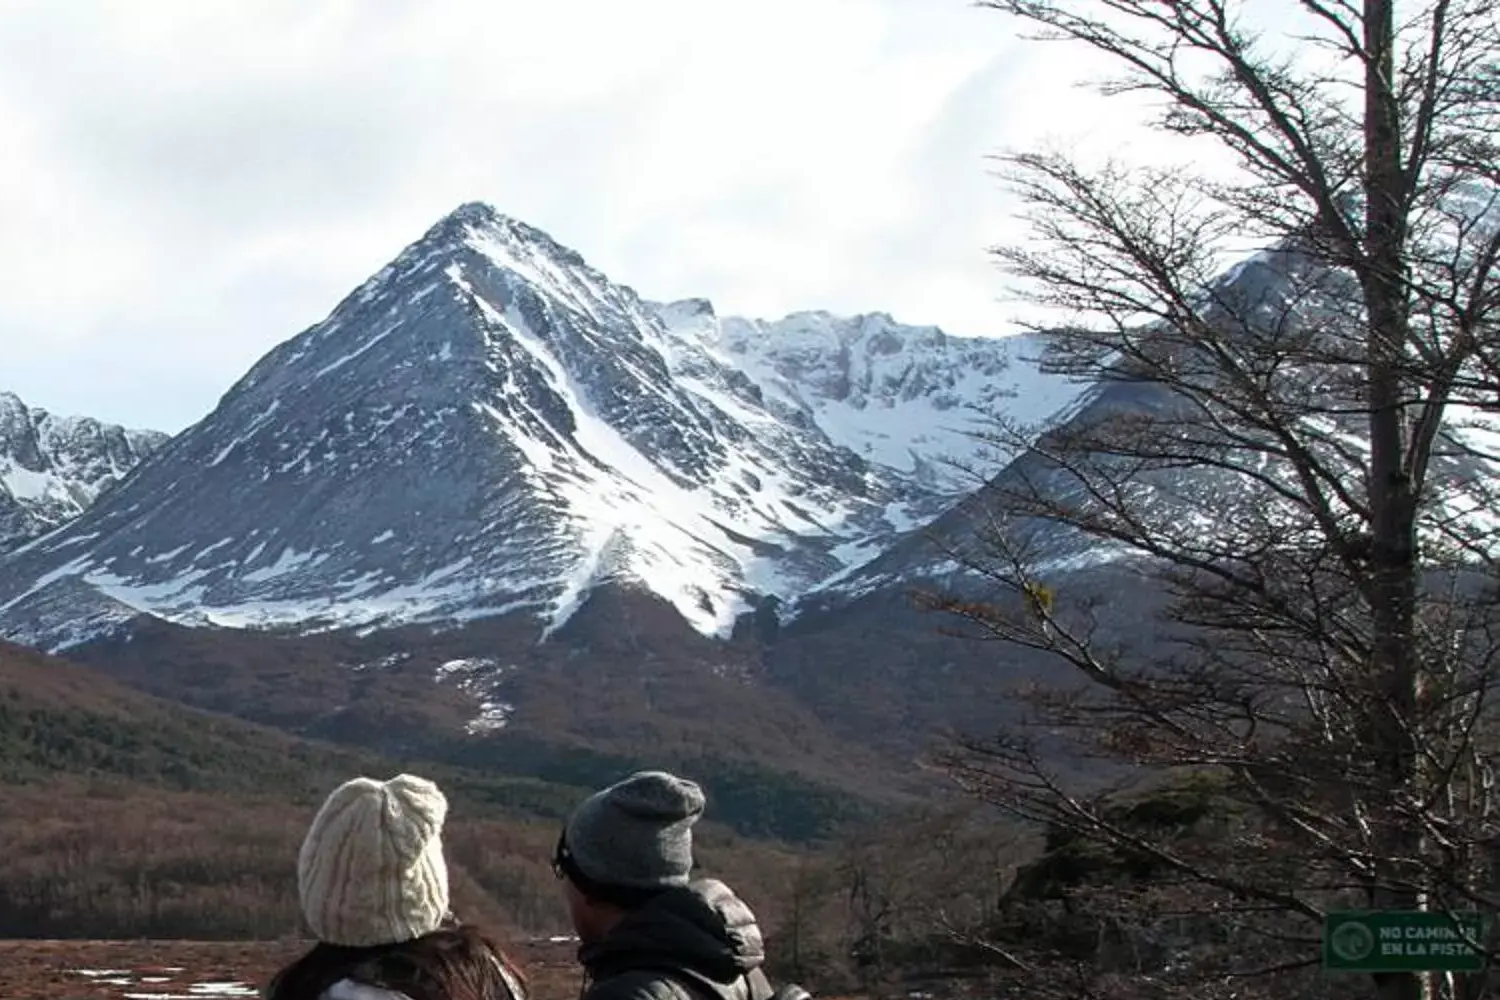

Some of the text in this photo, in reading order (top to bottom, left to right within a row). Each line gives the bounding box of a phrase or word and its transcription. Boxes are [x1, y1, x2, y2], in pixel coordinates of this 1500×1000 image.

[1380, 926, 1476, 940] NO CAMINR
[1381, 943, 1475, 956] EN LA PISTA
